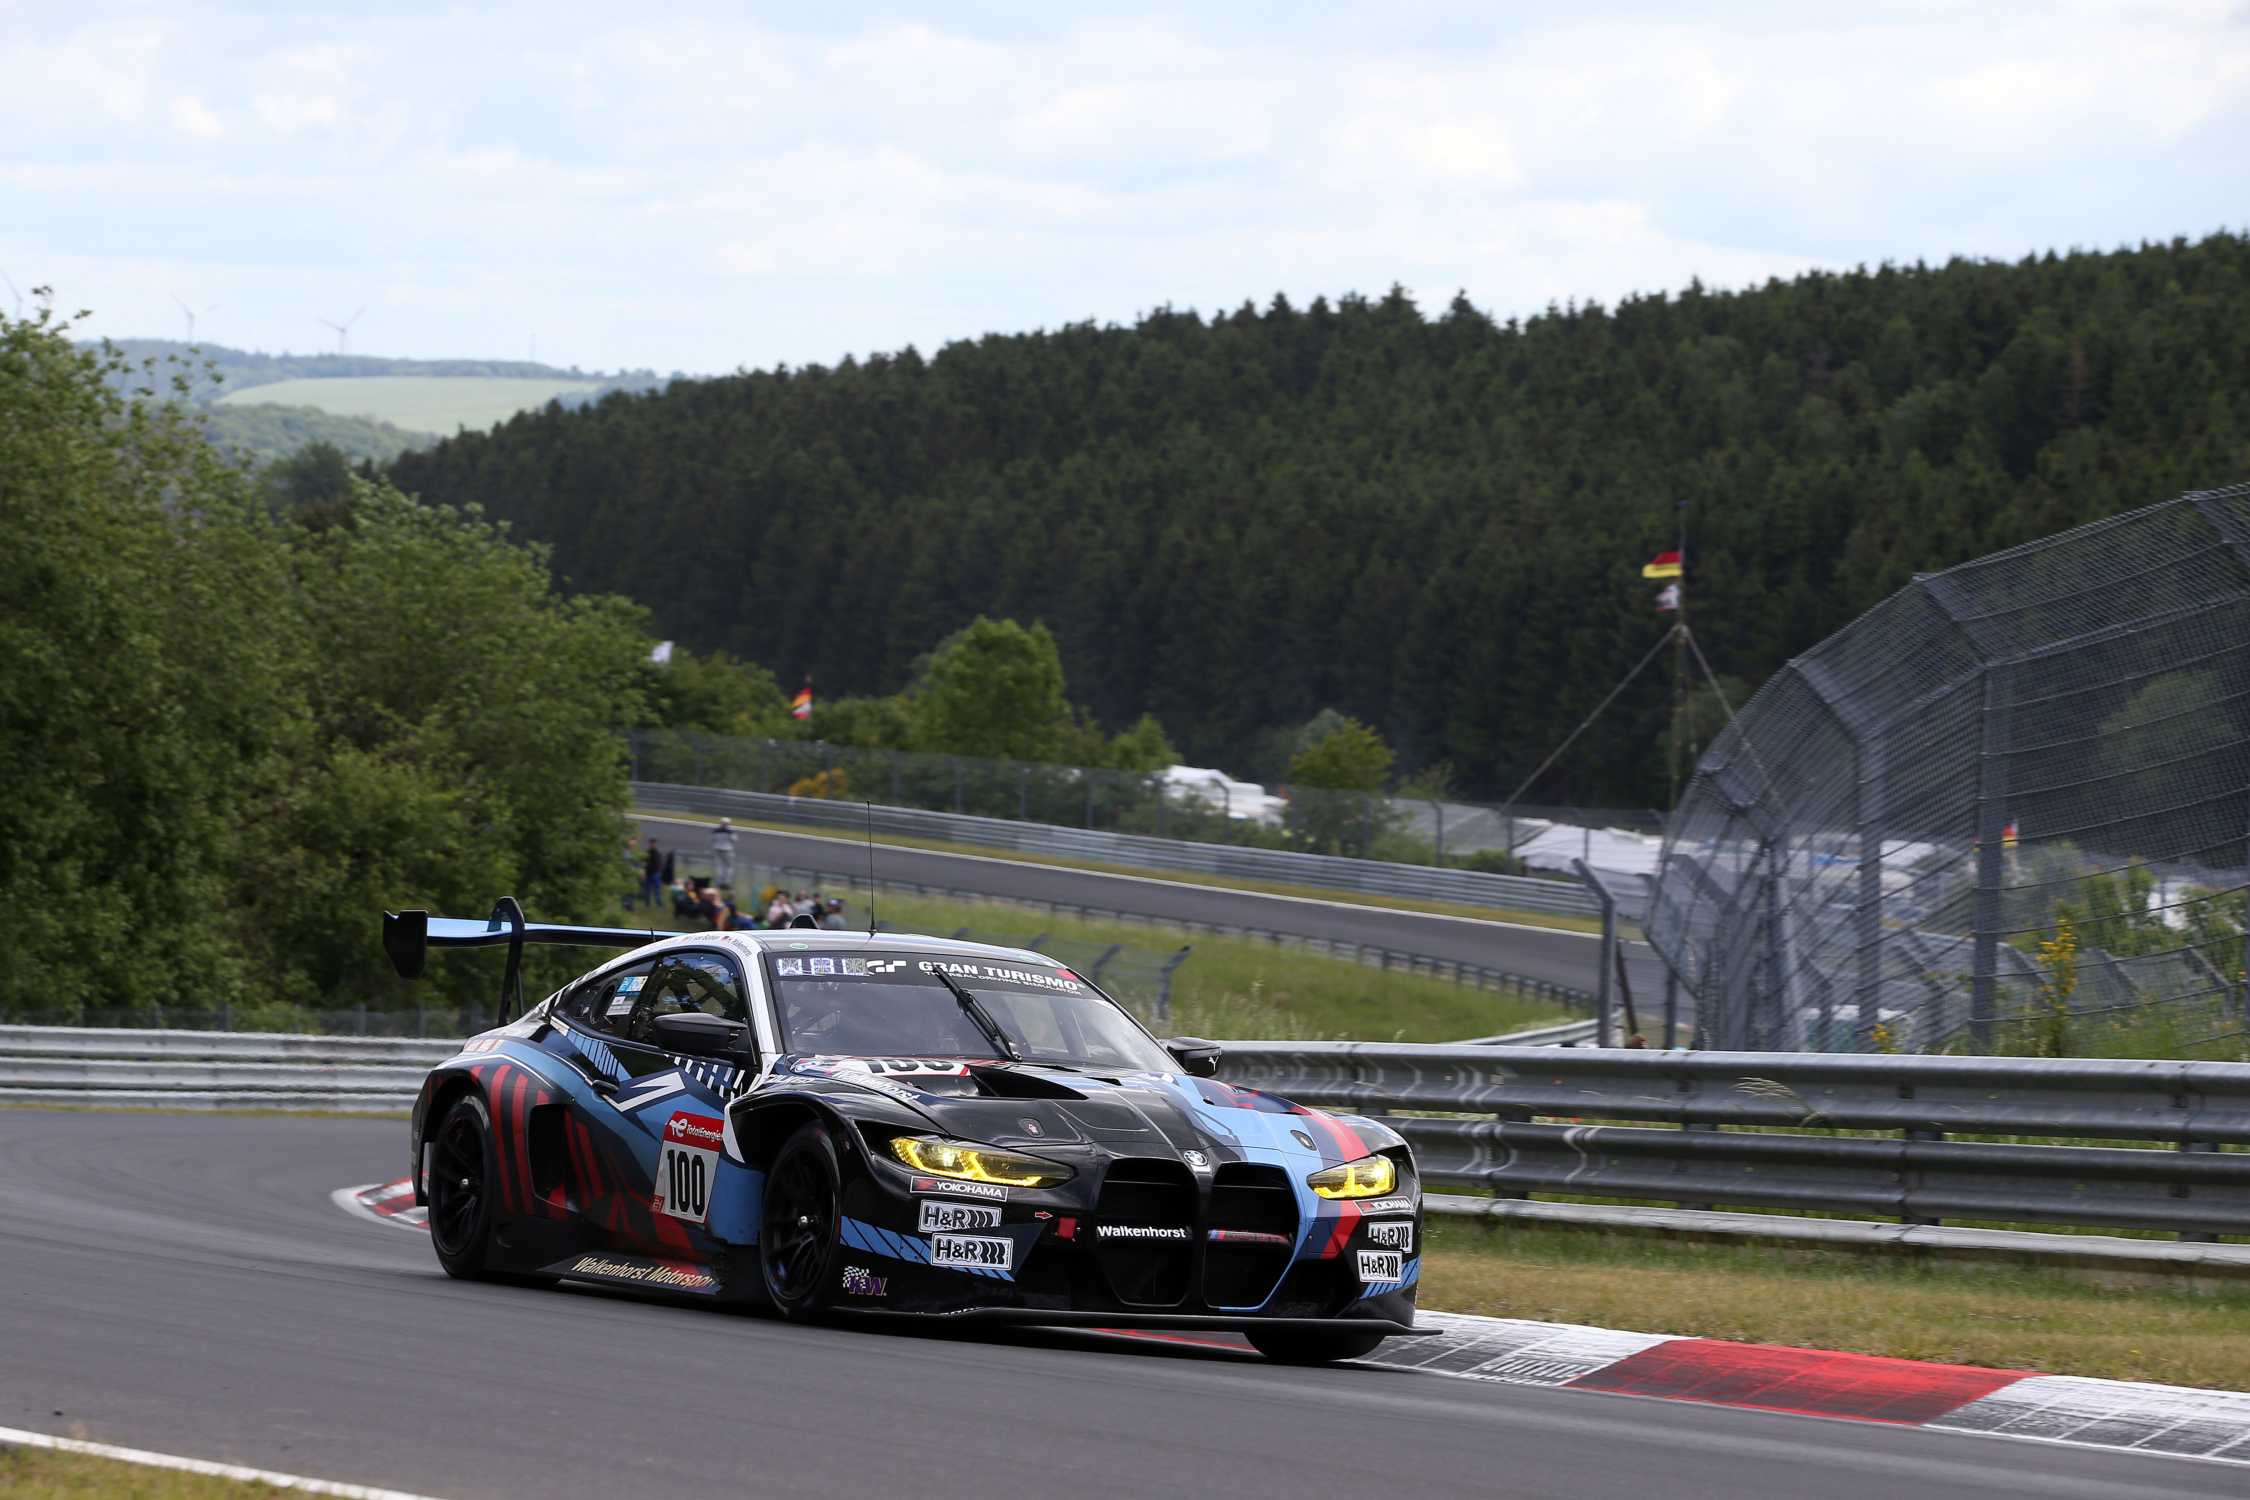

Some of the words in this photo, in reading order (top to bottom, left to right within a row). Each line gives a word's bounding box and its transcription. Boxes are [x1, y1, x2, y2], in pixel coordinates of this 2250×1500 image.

[918, 961, 979, 975] GRAN
[983, 966, 1078, 991] TURISMO
[667, 1149, 706, 1216] 100
[936, 1181, 1003, 1198] YOKOHAMA
[924, 1204, 966, 1229] H&R
[1096, 1225, 1187, 1239] Walkenhorst
[935, 1238, 978, 1261] H&R
[570, 1256, 652, 1280] Walkenhorst
[1360, 1255, 1387, 1275] H&R
